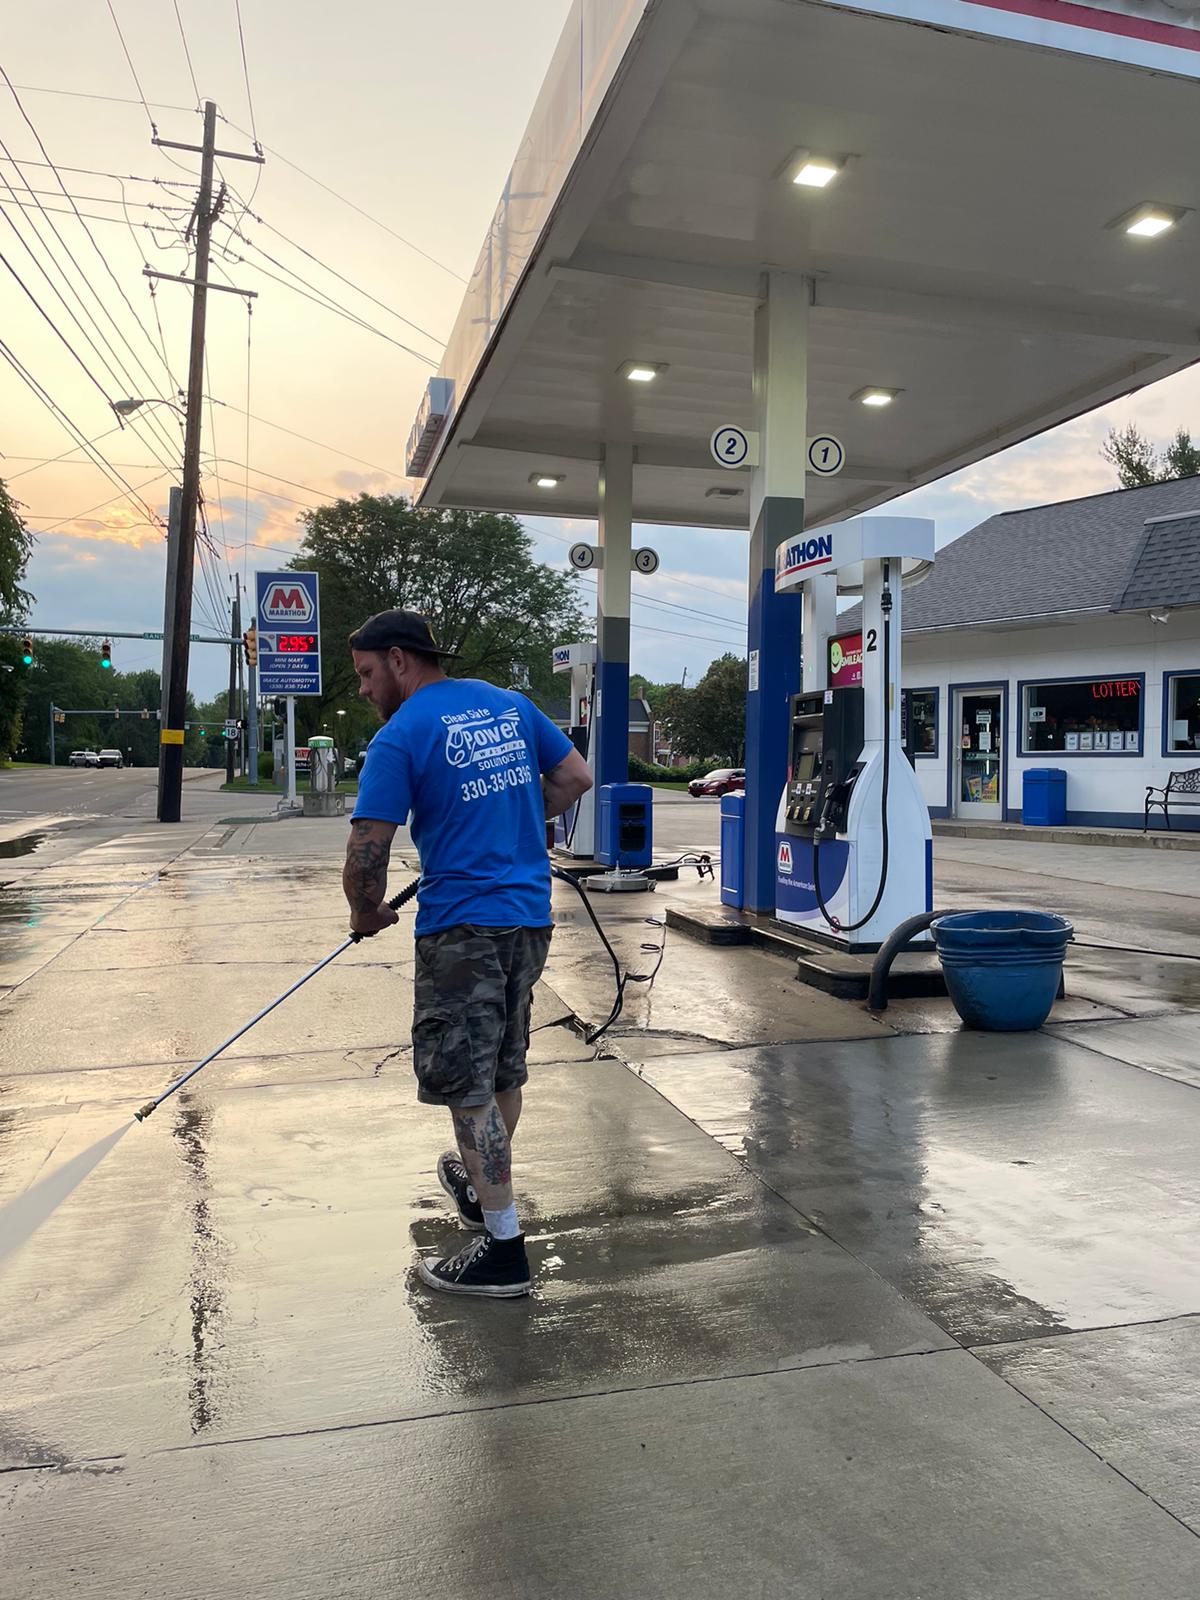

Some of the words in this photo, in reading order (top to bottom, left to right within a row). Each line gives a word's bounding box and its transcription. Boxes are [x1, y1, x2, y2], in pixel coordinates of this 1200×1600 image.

[725, 437, 737, 455] 2
[820, 446, 830, 463] 1
[577, 550, 586, 562] 4
[642, 555, 650, 567] 3
[270, 588, 305, 609] M
[866, 629, 877, 652] 2
[440, 713, 469, 725] Clean
[466, 707, 491, 720] Slate
[227, 728, 236, 736] 18
[462, 720, 519, 750] Power
[780, 846, 790, 862] M
